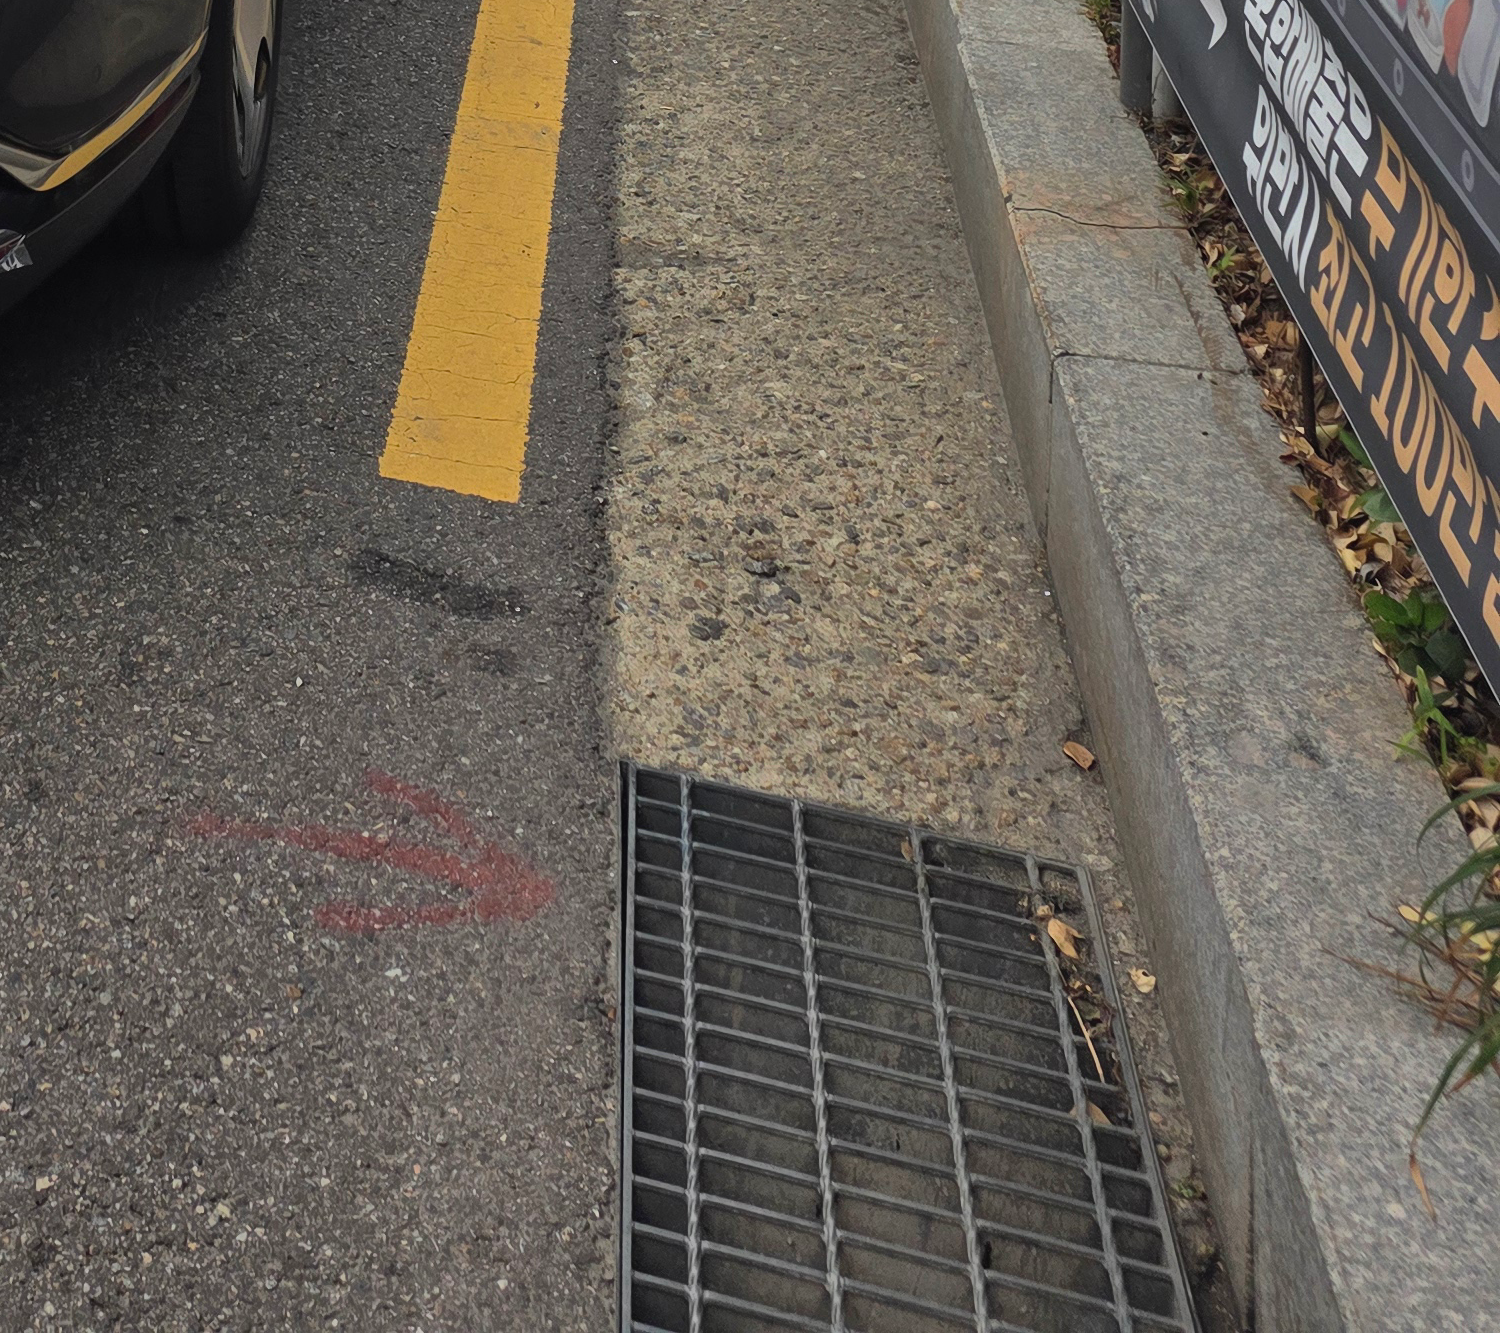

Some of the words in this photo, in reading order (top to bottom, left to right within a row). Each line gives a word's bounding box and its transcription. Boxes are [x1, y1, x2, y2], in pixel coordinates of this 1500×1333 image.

[1242, 84, 1321, 294] 위반시
[1310, 197, 1376, 394] 최고
[1360, 114, 1476, 375] 무기한
